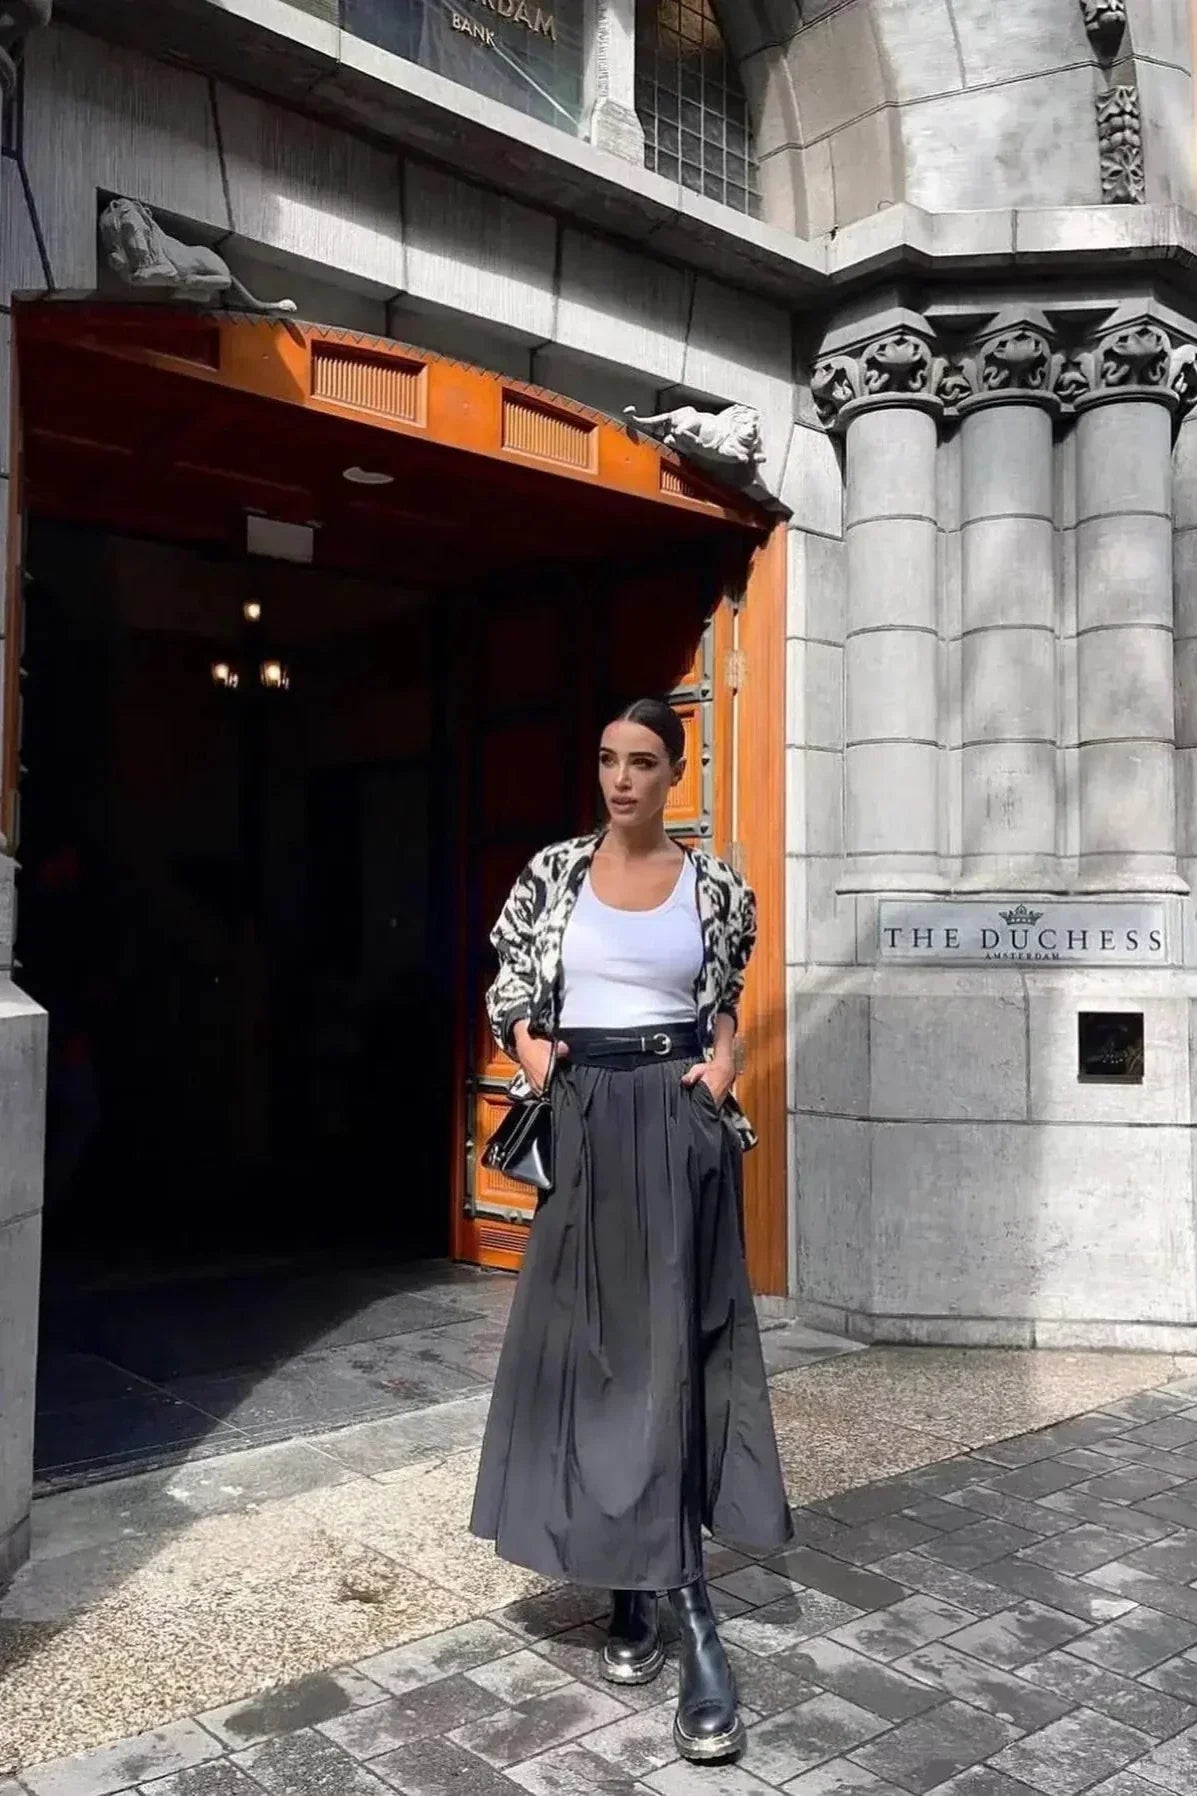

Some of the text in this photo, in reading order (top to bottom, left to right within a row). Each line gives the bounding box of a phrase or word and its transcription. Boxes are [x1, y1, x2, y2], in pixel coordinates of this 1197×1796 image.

[452, 12, 495, 45] BANK
[883, 927, 1161, 951] THE DUCHESS
[984, 952, 1060, 960] AMSTERDAM
